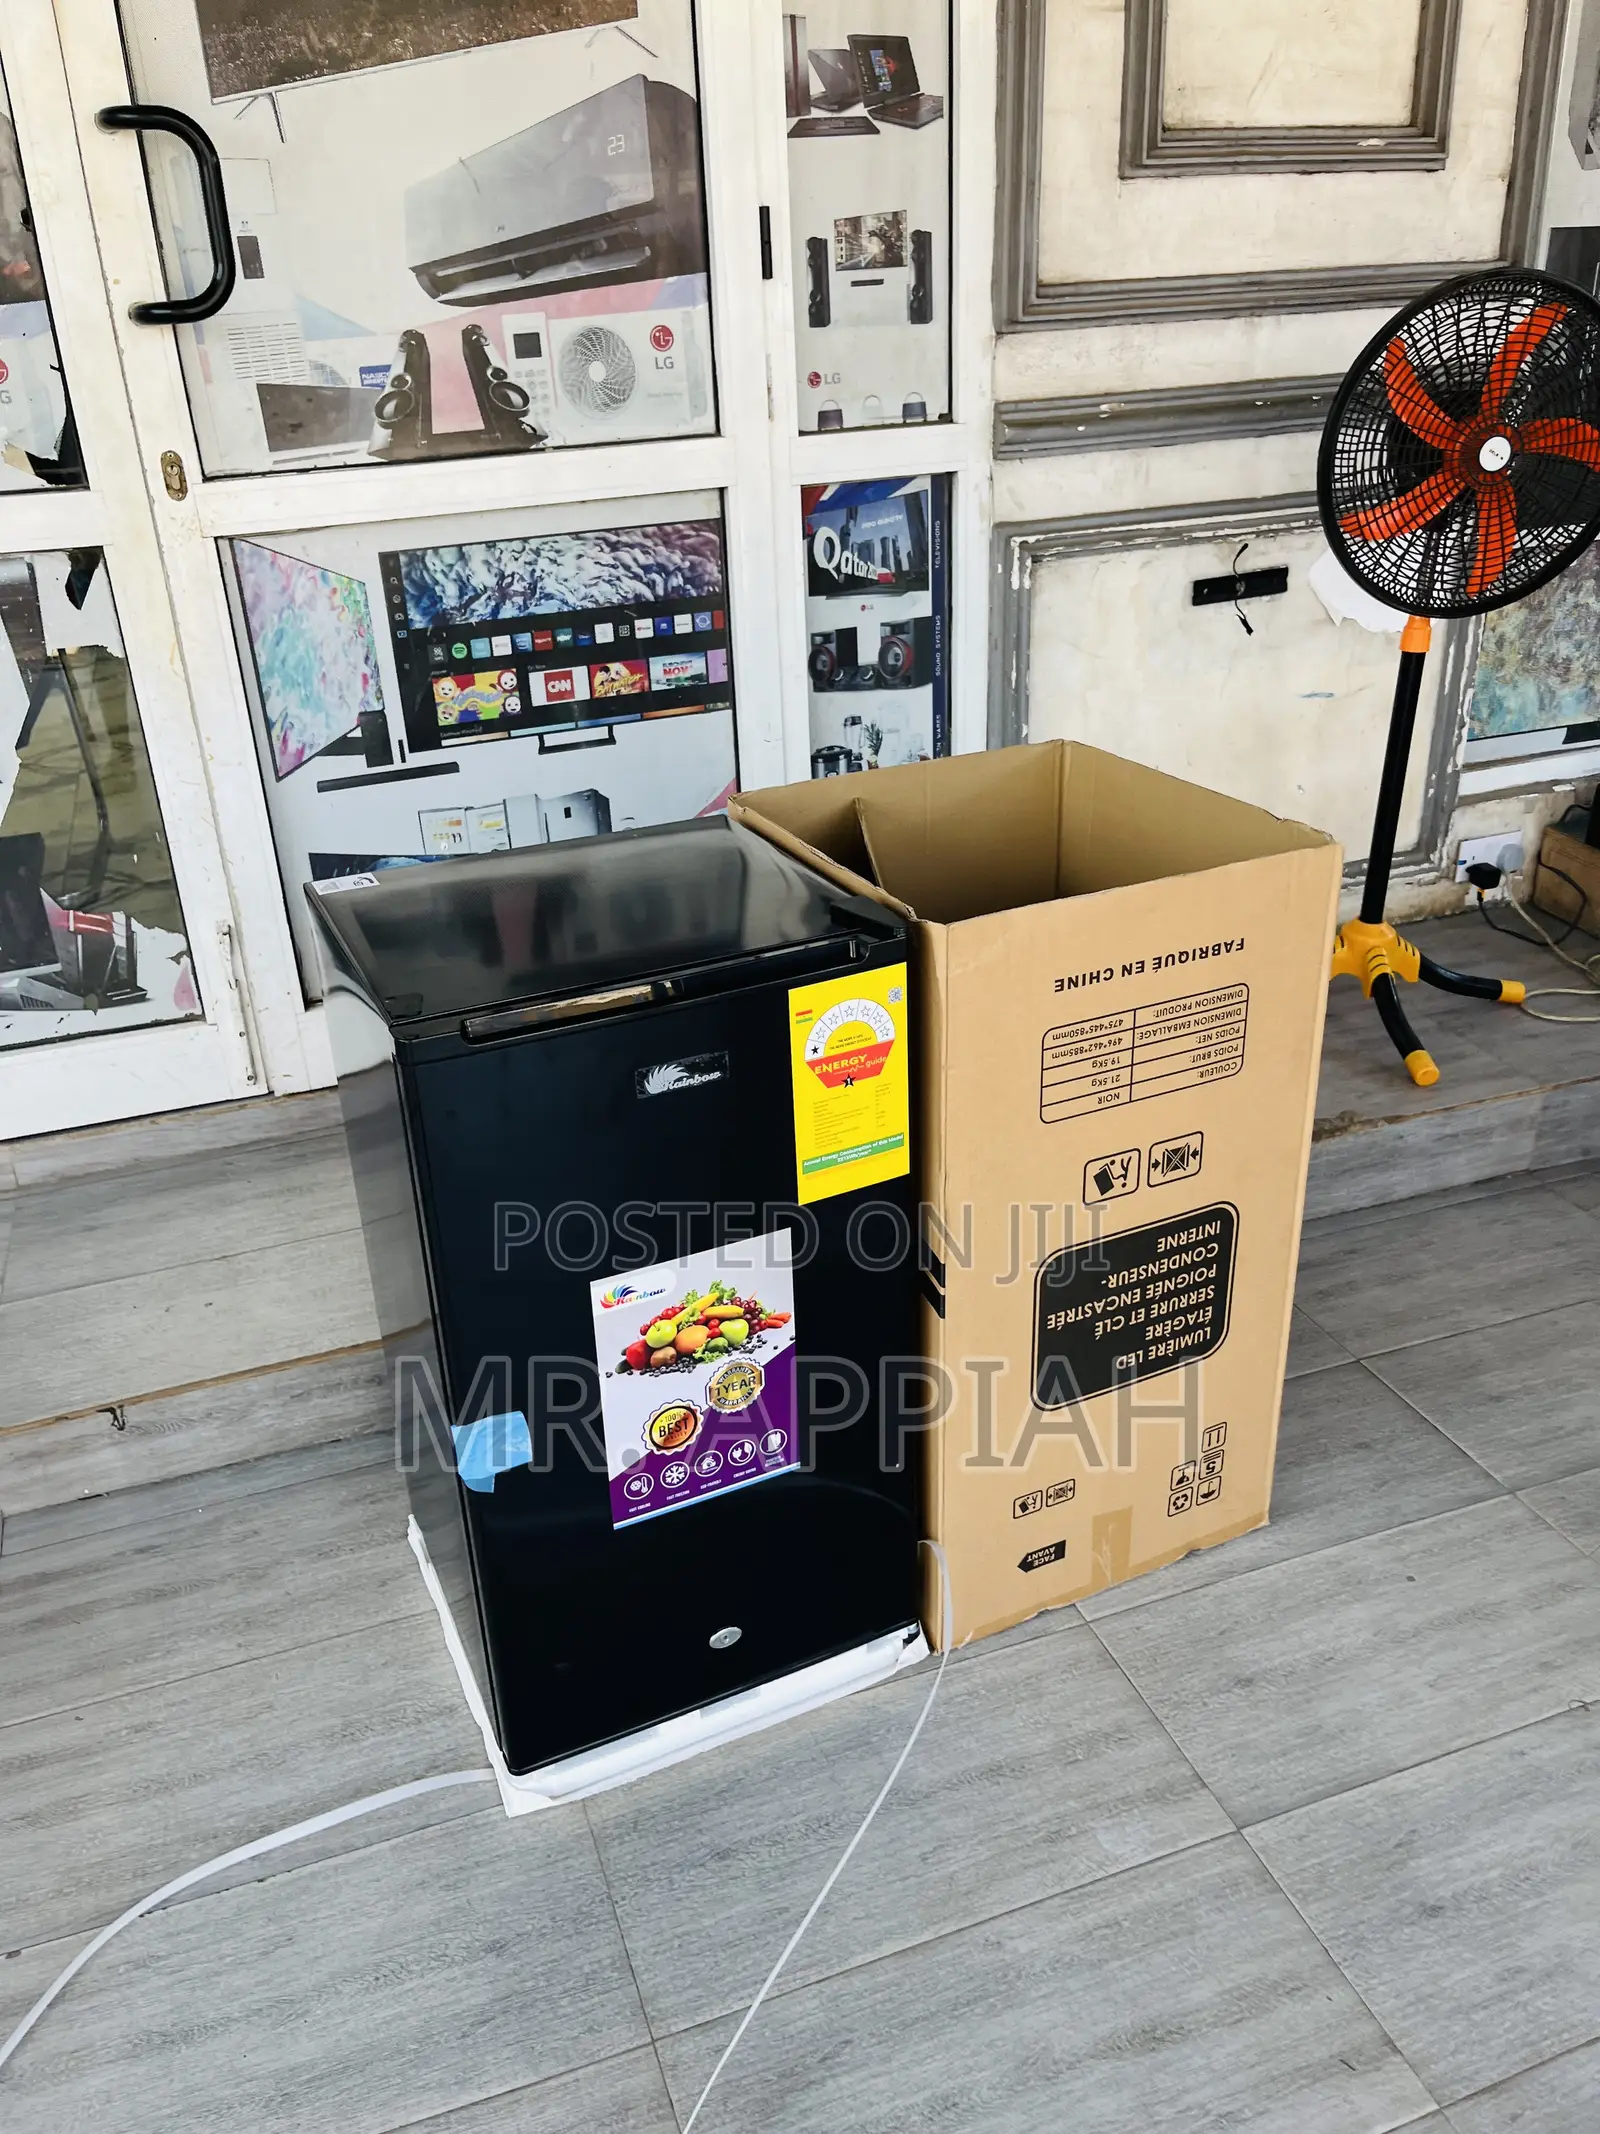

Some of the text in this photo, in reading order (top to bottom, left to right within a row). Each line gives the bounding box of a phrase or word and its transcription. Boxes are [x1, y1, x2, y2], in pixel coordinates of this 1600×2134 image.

[607, 134, 624, 155] 23
[655, 356, 674, 370] LG
[823, 372, 841, 385] LG
[547, 679, 572, 693] CNN
[1054, 938, 1245, 992] FABRIQUÉ EN CHINE
[1153, 989, 1243, 1018] DIMENSION PRODUIT:
[1137, 1008, 1242, 1040] DIMENSION EMBALLAGE:
[1196, 1026, 1240, 1044] POIDS NET:
[866, 1056, 887, 1068] guide
[1190, 1044, 1239, 1063] POIDS BRUT:
[814, 1054, 867, 1075] ENERGY
[1197, 1061, 1237, 1078] COULEUR:
[1097, 1092, 1120, 1104] NOIR
[1157, 1220, 1221, 1252] INTERNE
[1101, 1243, 1219, 1289] CONDENSEUR-
[1047, 1264, 1217, 1331] POIGNÉE ENCASTRÉE
[1094, 1285, 1215, 1340] SERRURE ET CLÉ
[1145, 1306, 1213, 1340] ÉTAGÈRE
[1116, 1327, 1211, 1370] LUMIÈRE LED
[716, 1366, 755, 1385] WARRANTY
[722, 1375, 757, 1394] YEAR
[659, 1417, 689, 1438] BEST
[1205, 1460, 1217, 1475] 5
[1027, 1546, 1056, 1562] AVANT
[1033, 1553, 1055, 1567] FACE
